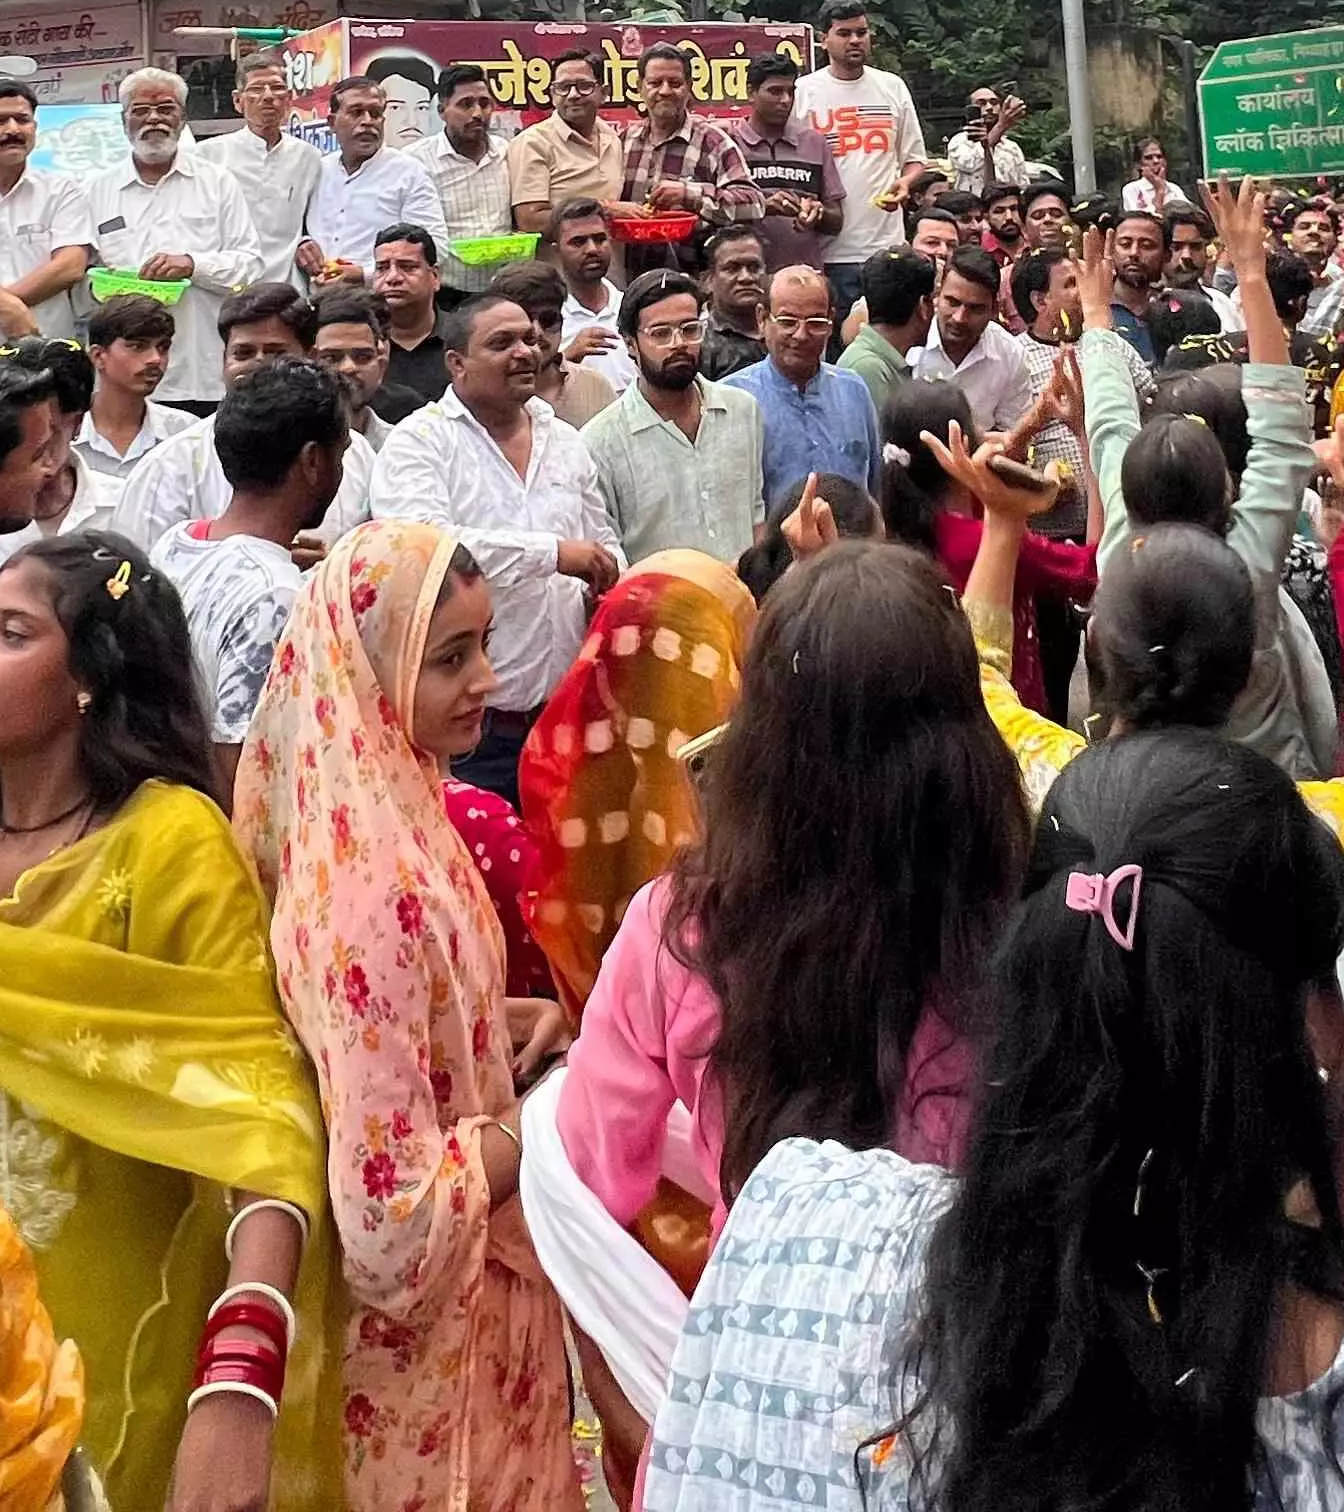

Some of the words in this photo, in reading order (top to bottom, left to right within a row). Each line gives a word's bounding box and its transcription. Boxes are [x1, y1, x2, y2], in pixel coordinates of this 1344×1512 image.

[1235, 84, 1316, 114] कार्यालय
[809, 106, 861, 134] US
[750, 165, 813, 183] URBERRY
